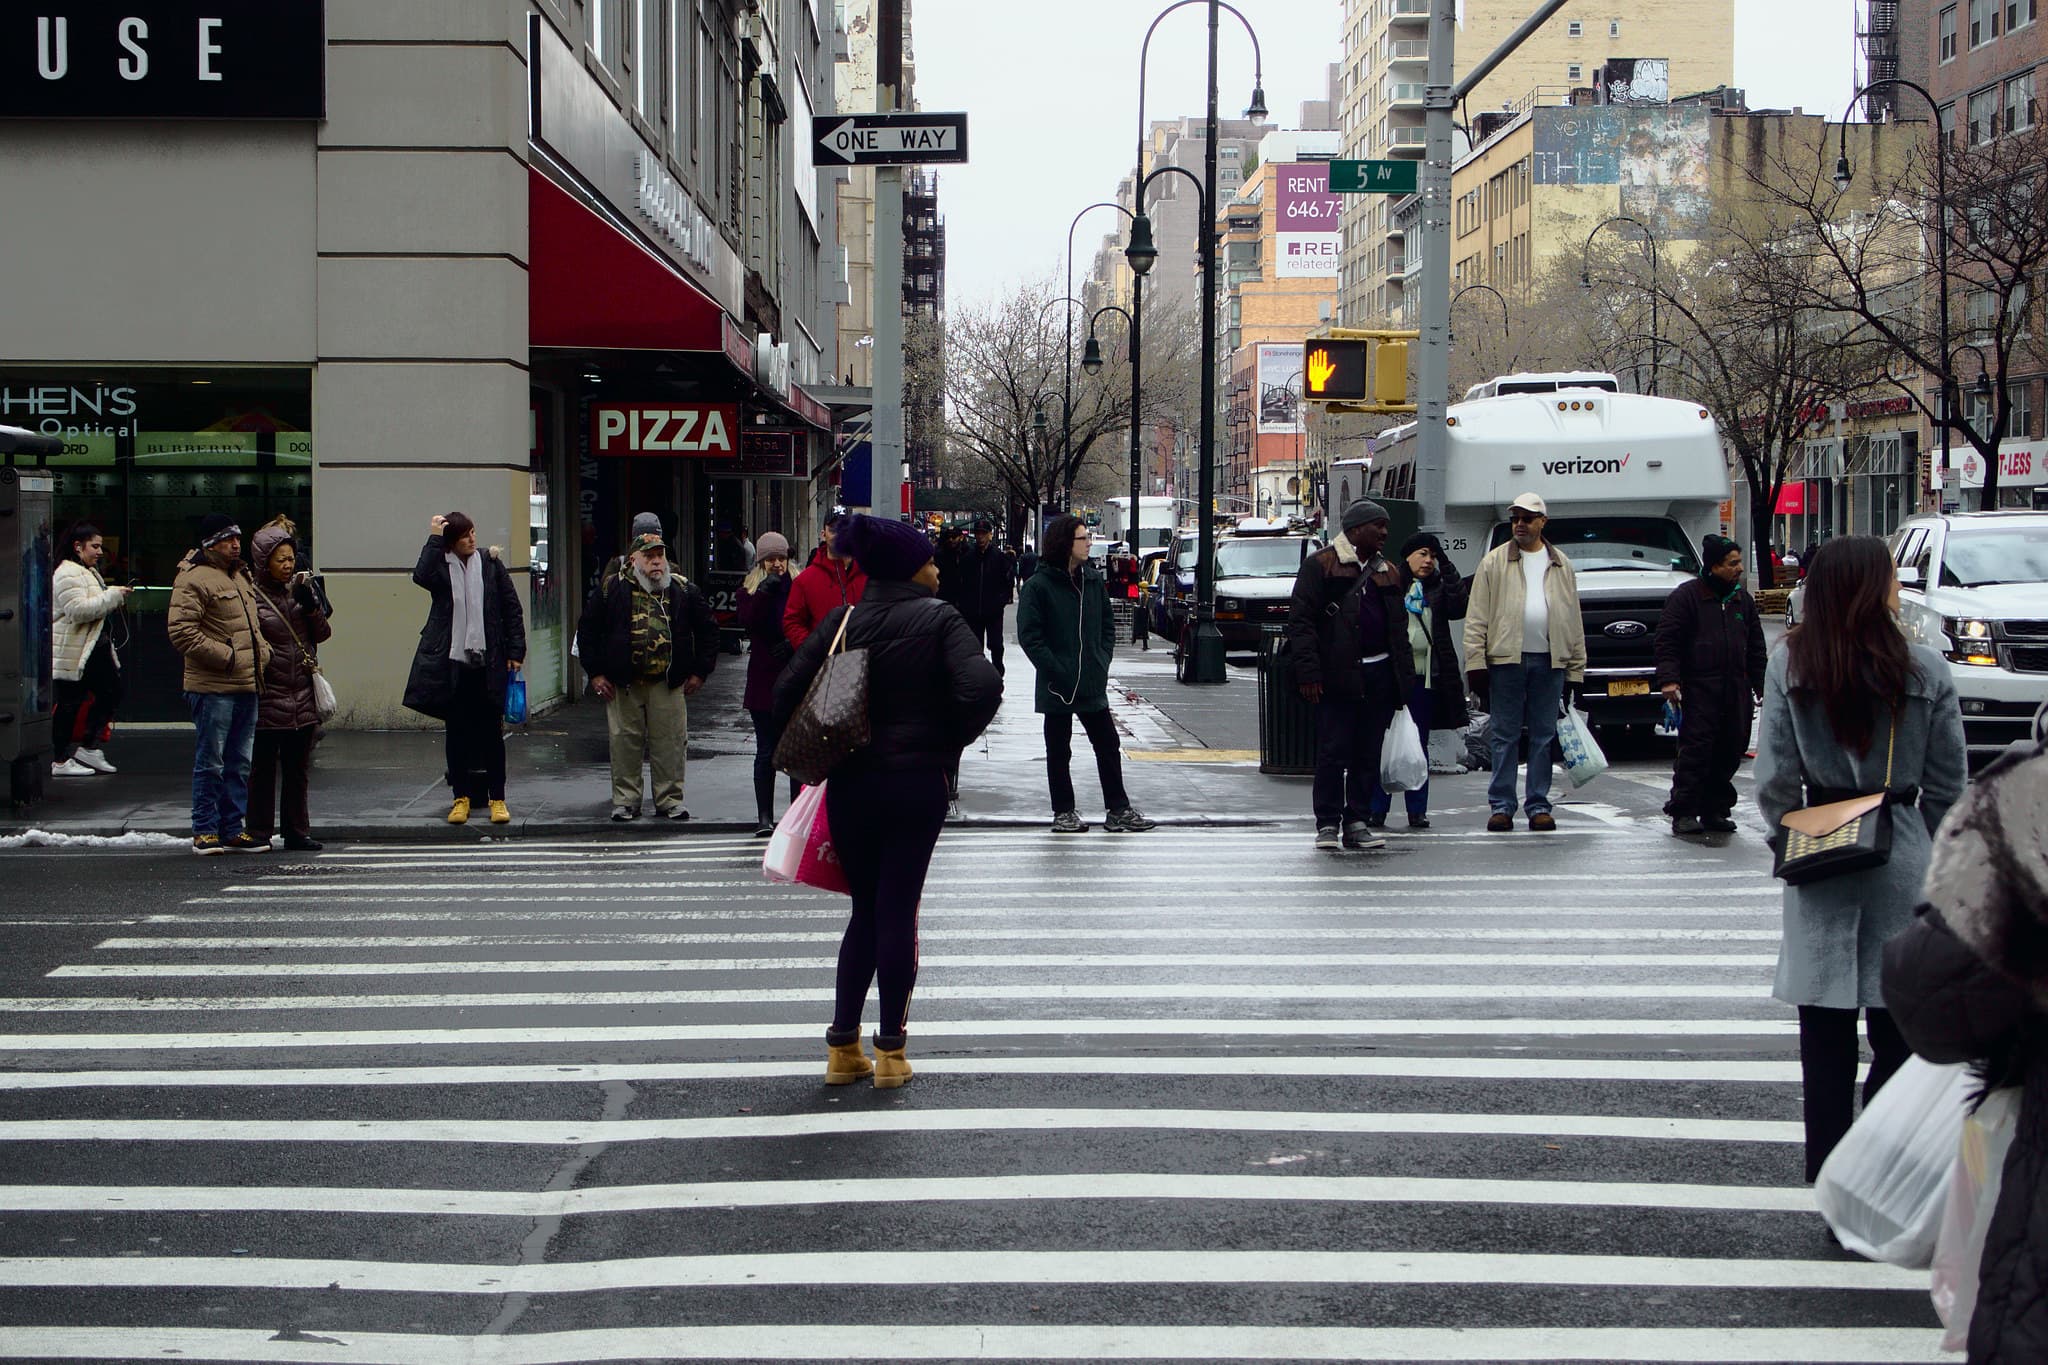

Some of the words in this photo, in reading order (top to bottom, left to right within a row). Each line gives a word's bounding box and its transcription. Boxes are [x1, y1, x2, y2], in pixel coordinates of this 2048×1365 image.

[836, 130, 879, 150] ONE
[900, 129, 946, 149] WAY
[1288, 177, 1326, 193] RENT
[1357, 164, 1369, 189] 5
[1377, 164, 1392, 180] Av
[39, 417, 138, 439] Optical
[599, 409, 731, 450] PIZZA
[147, 443, 244, 454] BURBERRY
[1542, 456, 1621, 475] verizon
[1452, 538, 1467, 551] 25
